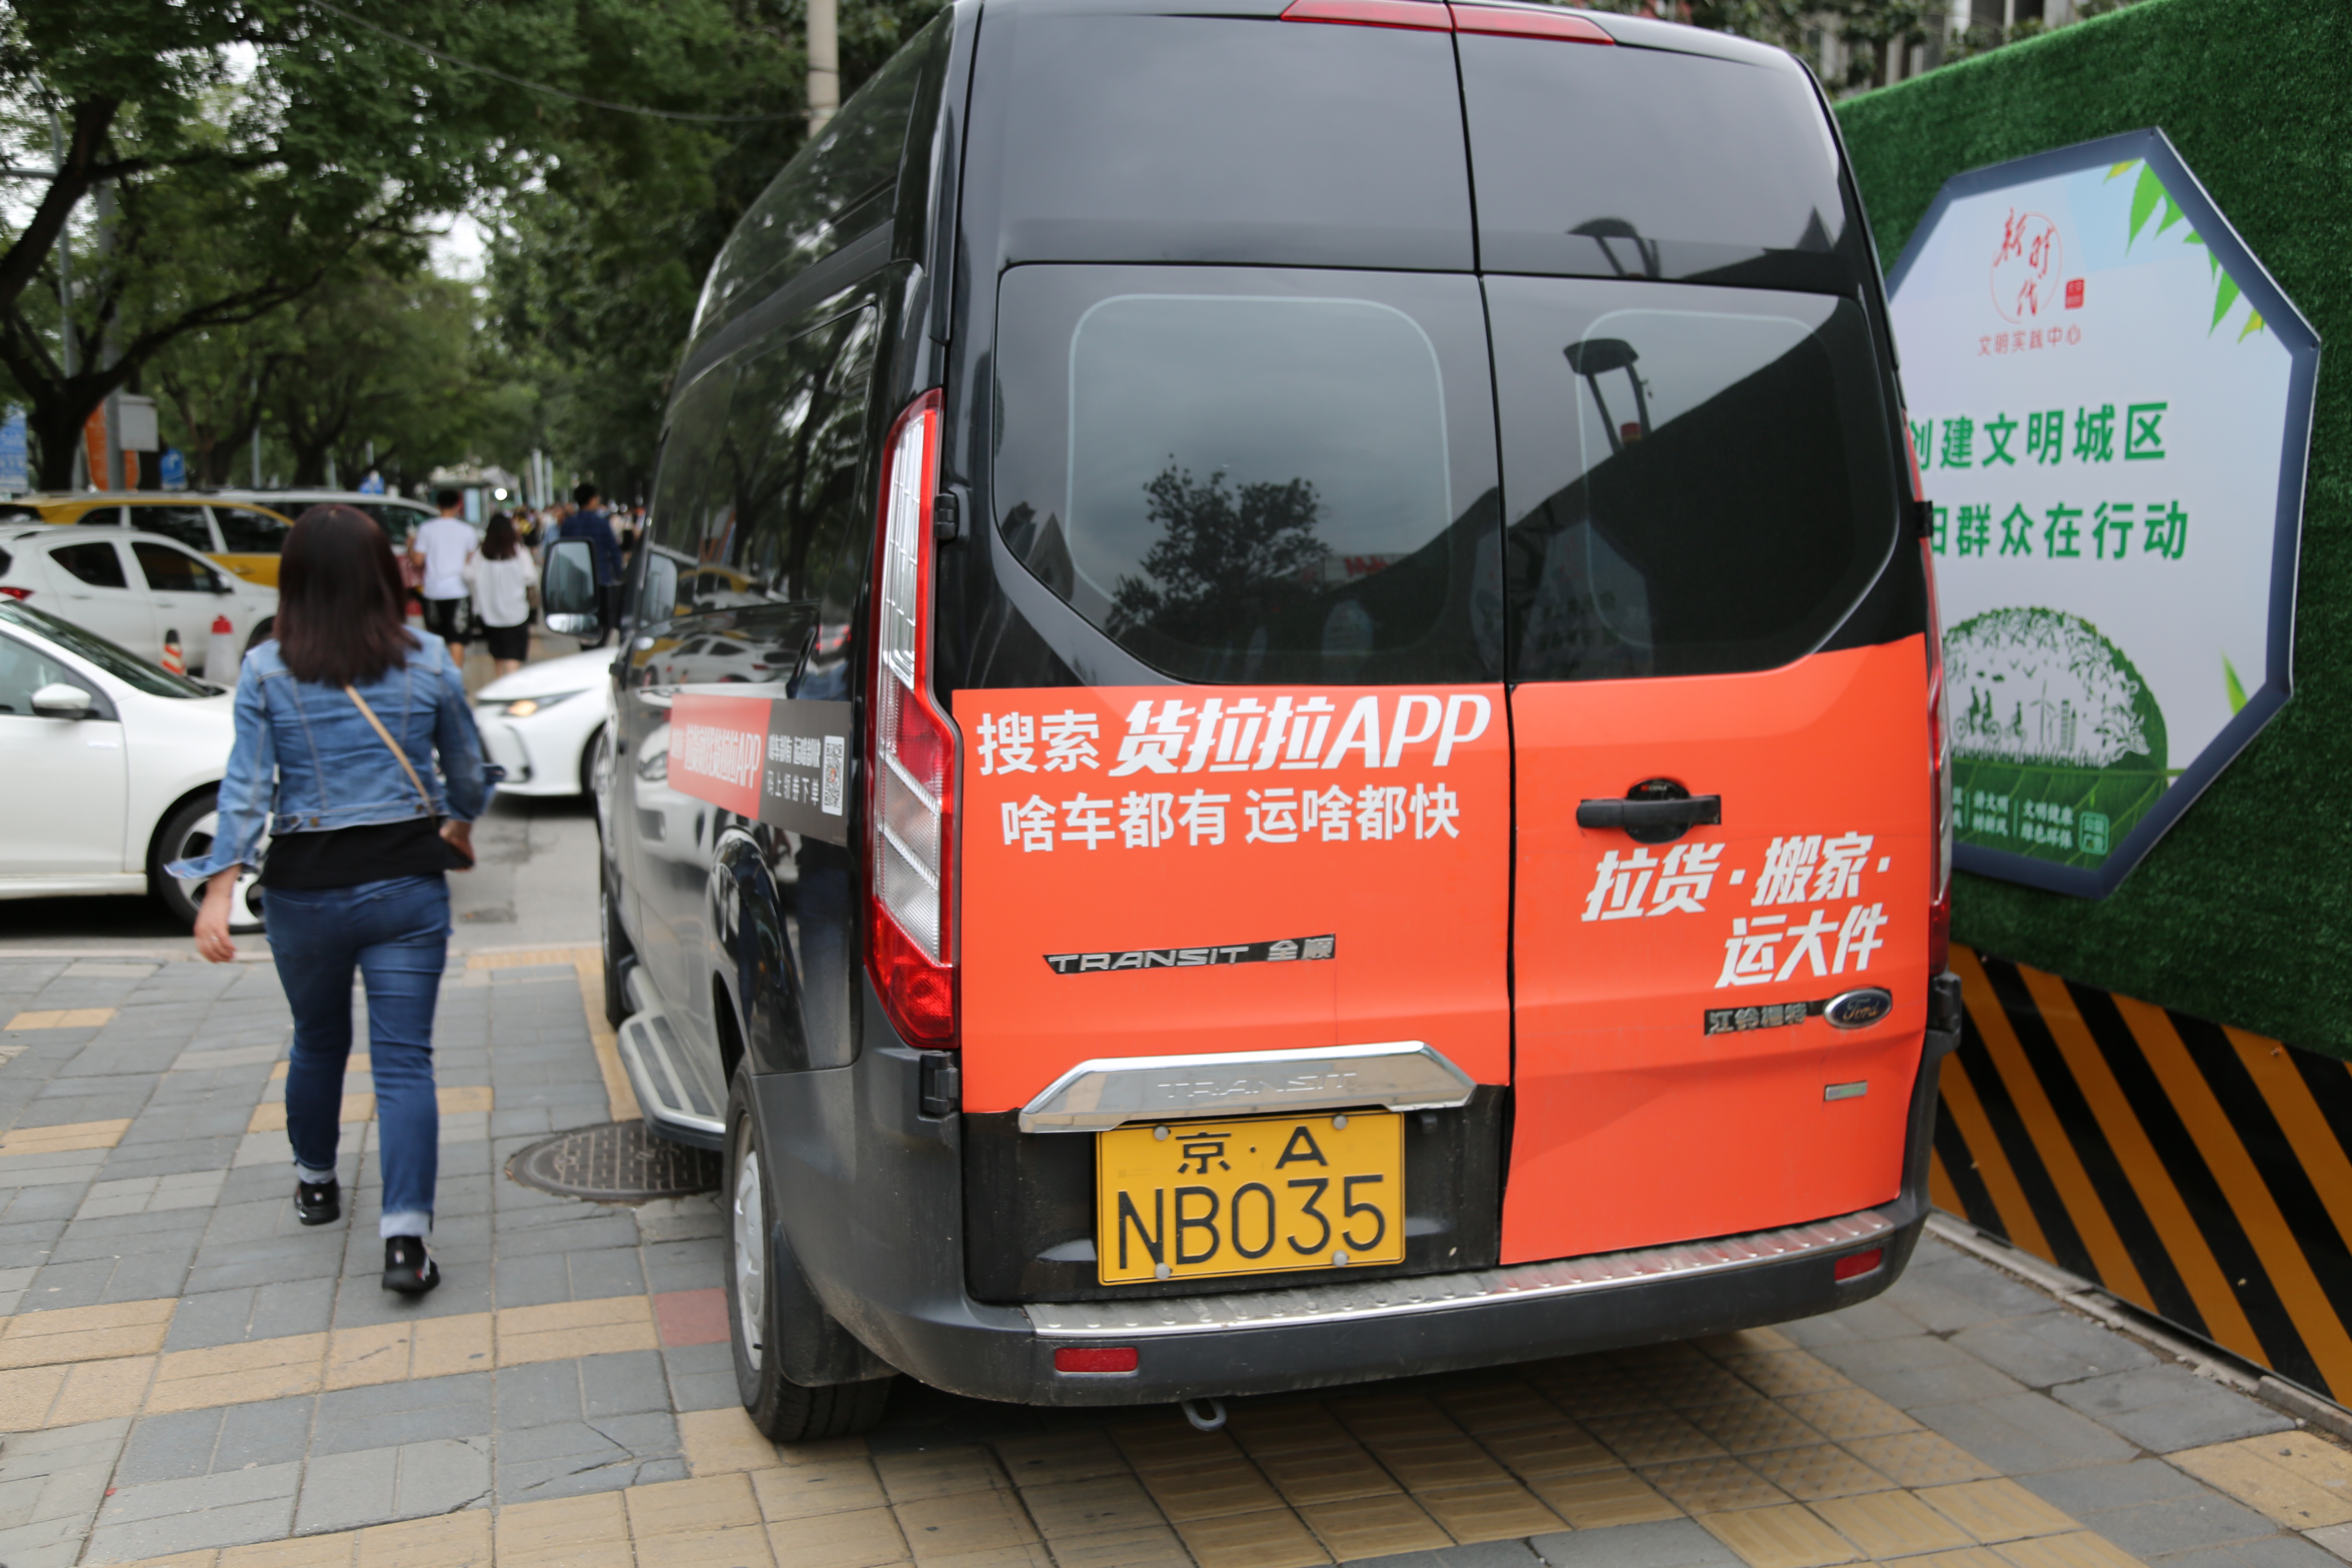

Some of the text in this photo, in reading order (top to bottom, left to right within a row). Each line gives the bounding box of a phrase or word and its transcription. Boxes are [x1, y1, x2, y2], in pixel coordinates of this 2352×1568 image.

[1977, 325, 2082, 356] 文明实践中心
[1906, 402, 2167, 470] 创建文明城区
[977, 694, 1491, 777] 搜索 货拉拉APP
[1001, 782, 1460, 852] 啥车都有 运啥都快
[1048, 937, 1334, 973] TRANSIT 全顺
[1714, 903, 1888, 988] 运大件
[1842, 996, 1879, 1022] Ford
[1156, 1071, 1358, 1098] TRANSIT
[1117, 1173, 1386, 1270] NB035
